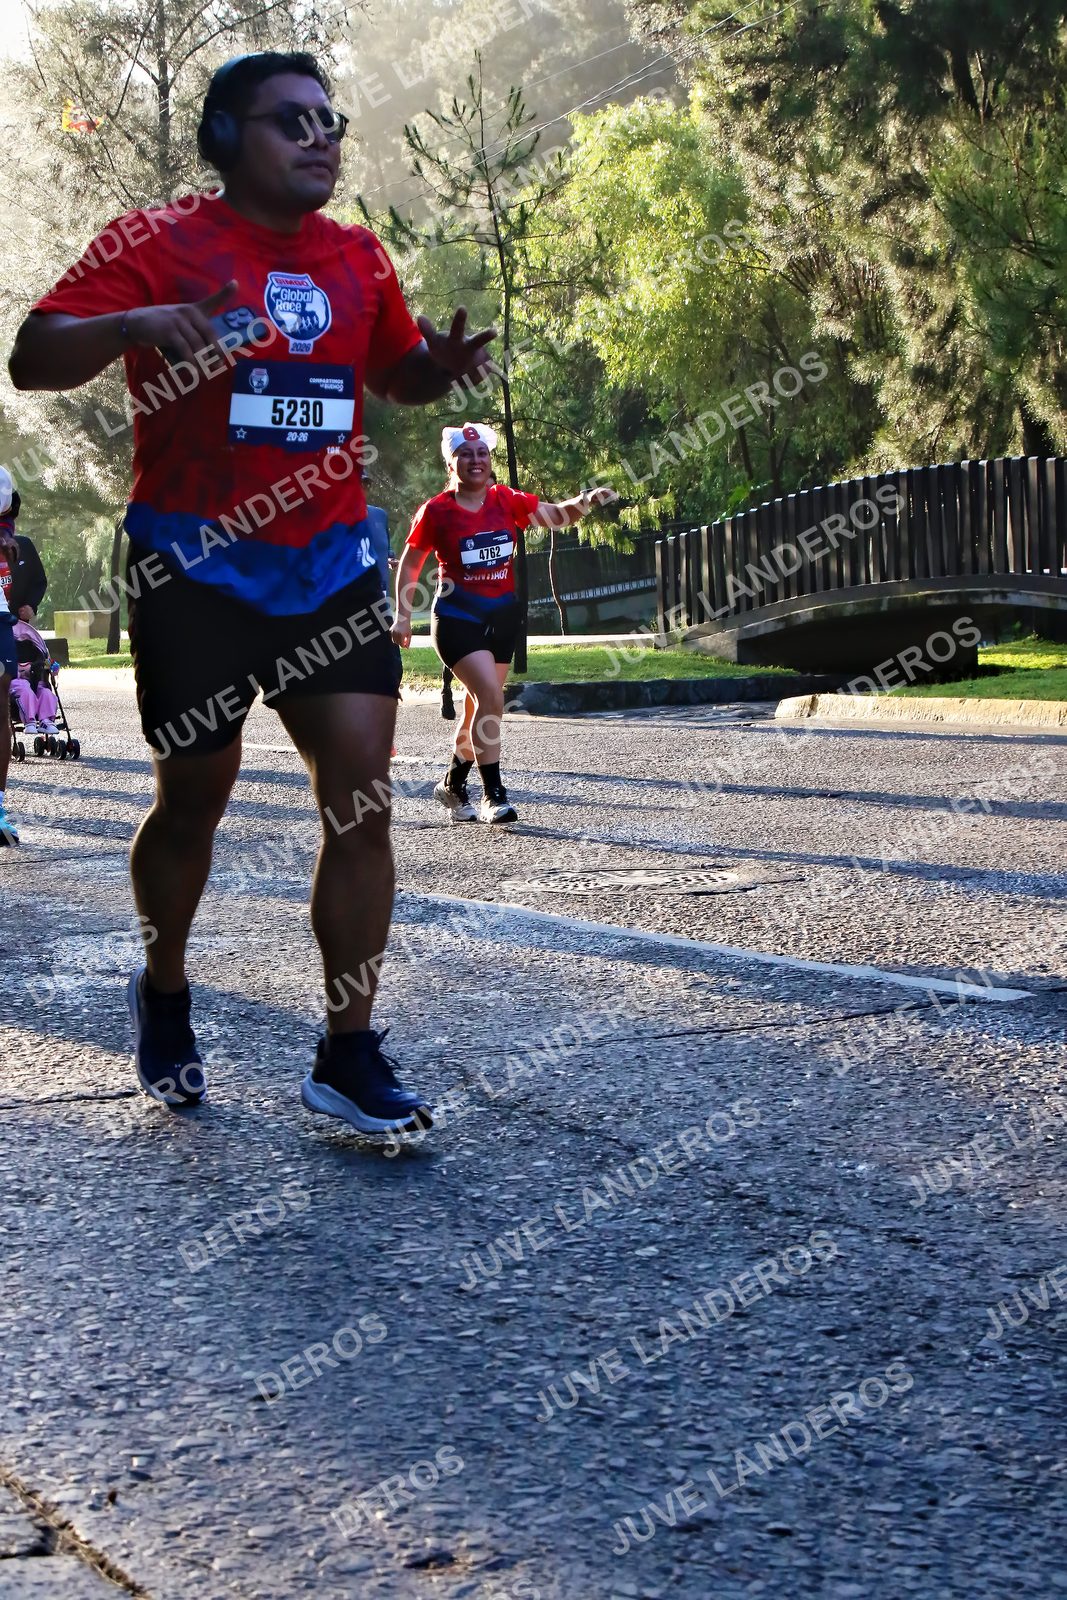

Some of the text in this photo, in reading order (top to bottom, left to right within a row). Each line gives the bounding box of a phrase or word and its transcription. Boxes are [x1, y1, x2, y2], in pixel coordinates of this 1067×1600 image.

[280, 289, 313, 303] Global
[275, 299, 302, 312] Race
[290, 342, 311, 352] 2026
[271, 398, 323, 428] 5230
[479, 545, 502, 560] 4762
